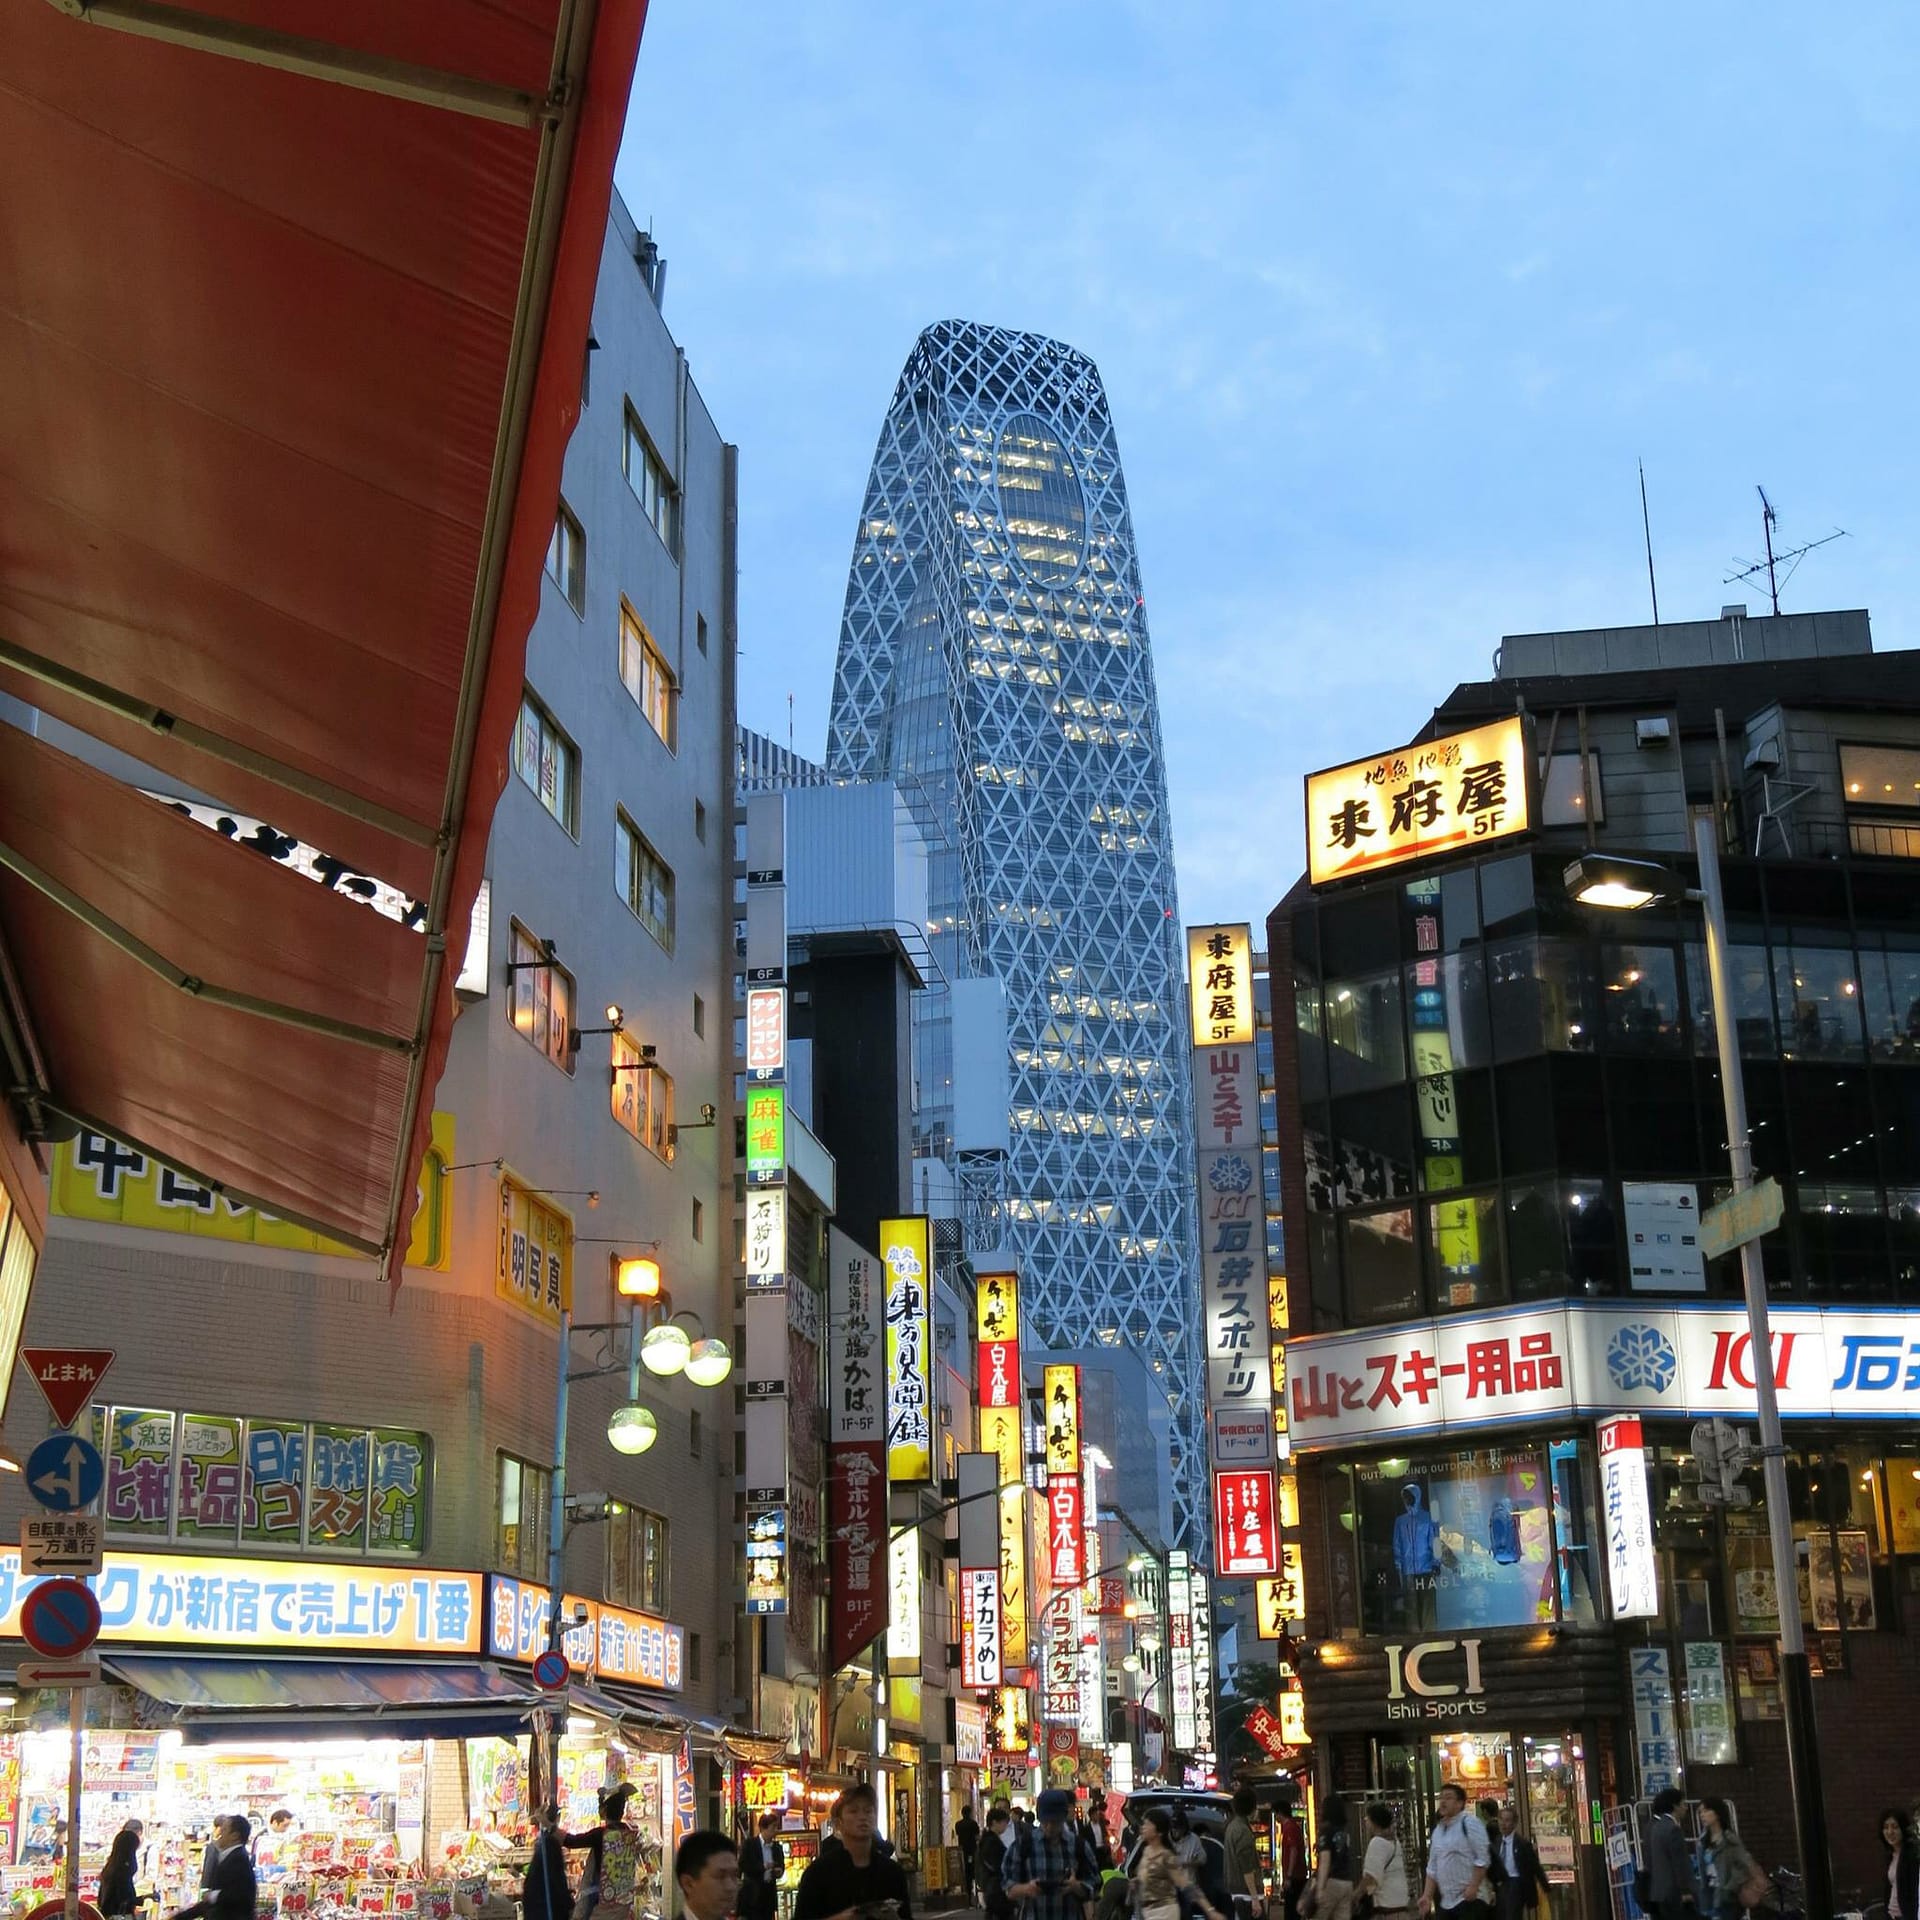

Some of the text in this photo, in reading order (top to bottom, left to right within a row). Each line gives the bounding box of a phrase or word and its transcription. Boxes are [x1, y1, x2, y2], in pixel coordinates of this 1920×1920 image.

[526, 718, 553, 796] 麻雀
[1327, 760, 1506, 849] 東府屋
[1473, 811, 1505, 836] 5F
[758, 872, 774, 882] 7F
[757, 968, 774, 979] 6F
[1206, 933, 1237, 1020] 東府屋
[1212, 1026, 1235, 1039] 5F
[757, 1069, 774, 1080] 6F
[1210, 1050, 1243, 1143] 山とスキー
[751, 1098, 779, 1151] 麻雀
[757, 1170, 774, 1181] 5F
[752, 1200, 773, 1269] 石狩川
[757, 1274, 774, 1286] 4F
[1213, 1221, 1256, 1398] 石井スポーツ
[40, 1366, 96, 1381] 止まれ
[990, 1343, 1011, 1406] 白木屋
[1293, 1332, 1564, 1422] 山とスキー用品
[1704, 1331, 1798, 1390] ICI
[757, 1382, 774, 1393] 3F
[251, 1431, 420, 1494] 日用雑貨
[264, 1486, 386, 1535] コスメ
[757, 1489, 775, 1501] 3F
[27, 1540, 96, 1555] 一方通行
[28, 1523, 97, 1538] 自転車を除く
[1053, 1490, 1080, 1577] 白木屋
[1606, 1462, 1629, 1612] 石井スポーツ
[0, 1558, 471, 1642] クが新宿で売上げ1番
[757, 1602, 775, 1612] B1
[847, 1600, 872, 1611] B1F
[600, 1614, 663, 1680] 新宿11号店
[976, 1584, 996, 1682] チカラめし
[1053, 1595, 1073, 1680] カラオケ
[1384, 1639, 1485, 1699] ICI
[1050, 1695, 1079, 1713] 24h
[1387, 1698, 1488, 1720] Ishii Sports
[1632, 1650, 1673, 1796] スキー用品
[744, 1774, 785, 1805] 新鮮
[993, 1765, 1027, 1778] チカラ
